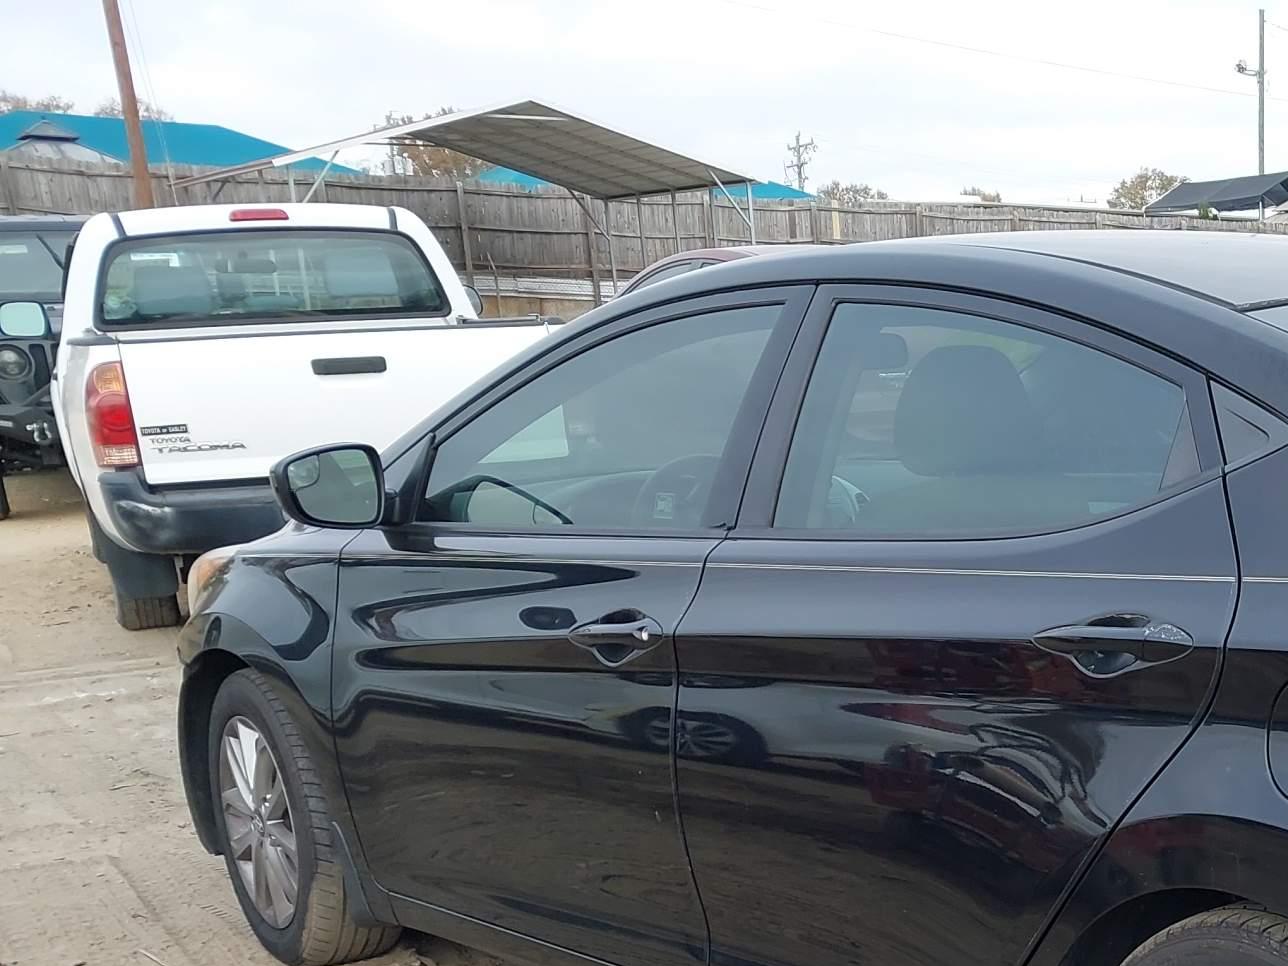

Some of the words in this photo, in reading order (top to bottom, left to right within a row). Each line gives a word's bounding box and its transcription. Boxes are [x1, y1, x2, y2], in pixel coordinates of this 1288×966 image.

[142, 427, 162, 435] TOYOTA
[149, 436, 192, 444] TOYOTA
[152, 442, 247, 454] TACOMA
